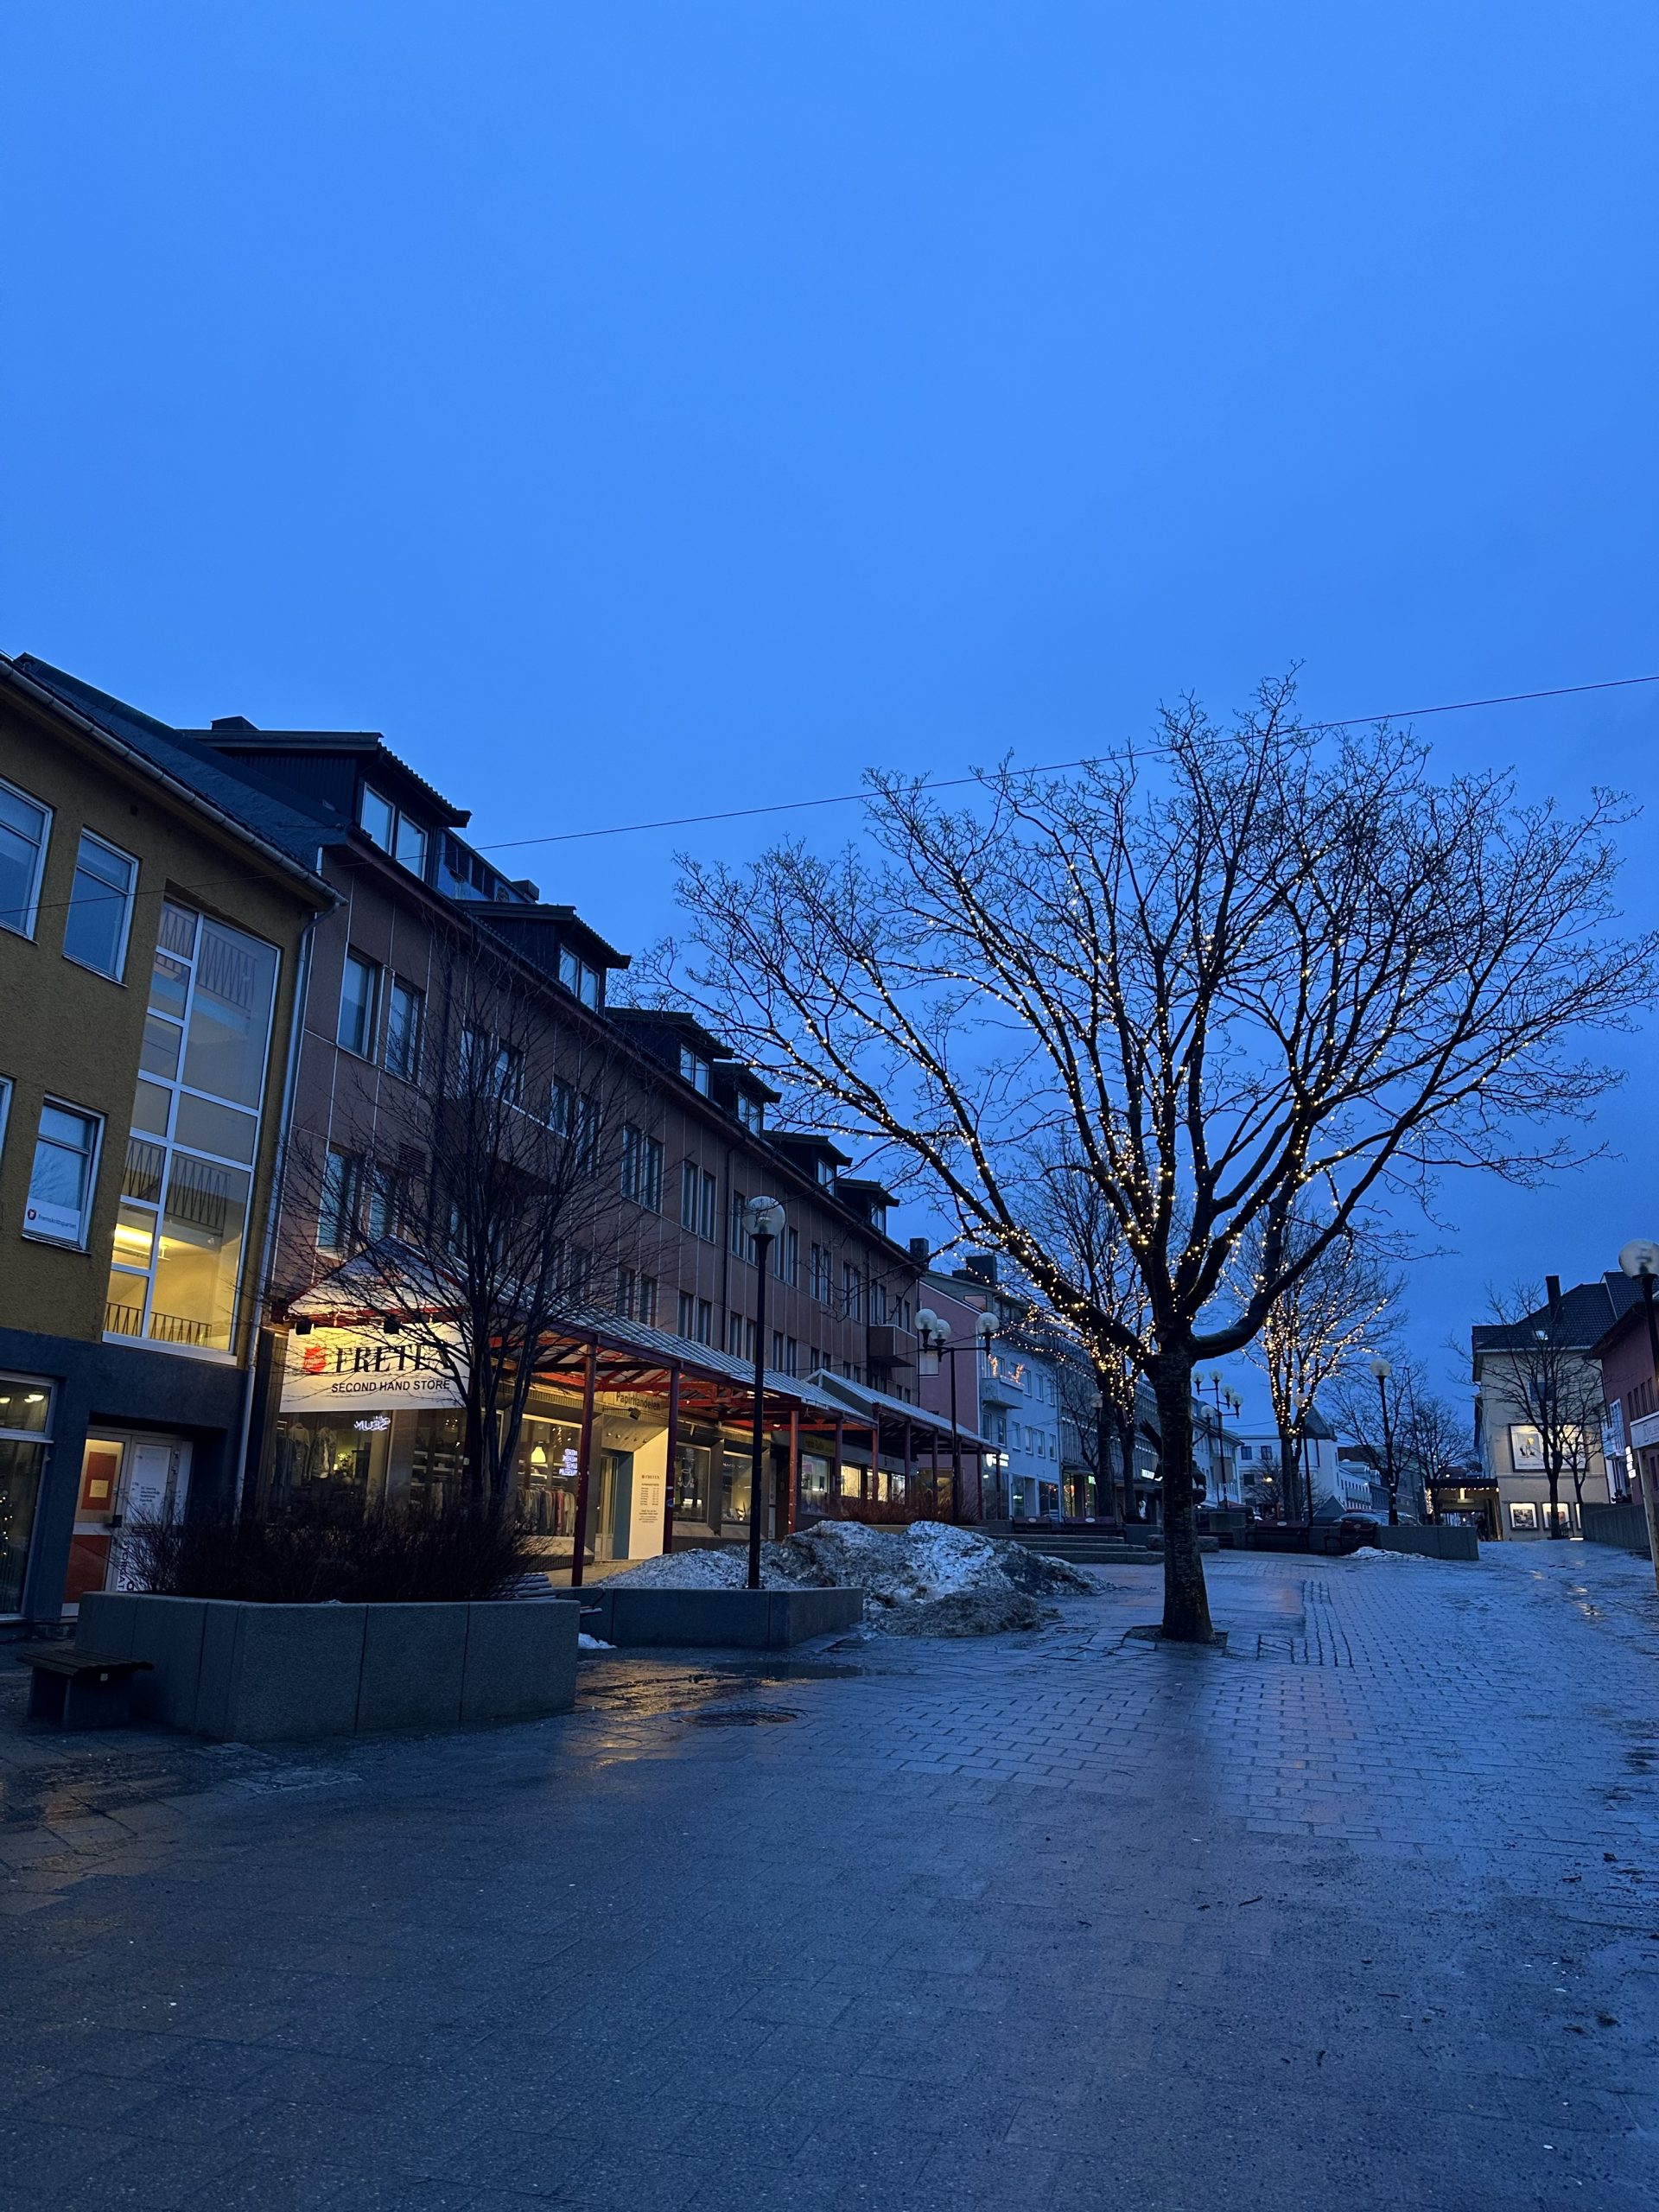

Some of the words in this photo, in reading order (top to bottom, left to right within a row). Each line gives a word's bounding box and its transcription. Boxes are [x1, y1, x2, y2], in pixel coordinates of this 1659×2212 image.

[332, 1382, 377, 1393] SECOND
[379, 1381, 410, 1392] HAND
[413, 1379, 450, 1390] STORE
[616, 1391, 660, 1410] Papirhandelen
